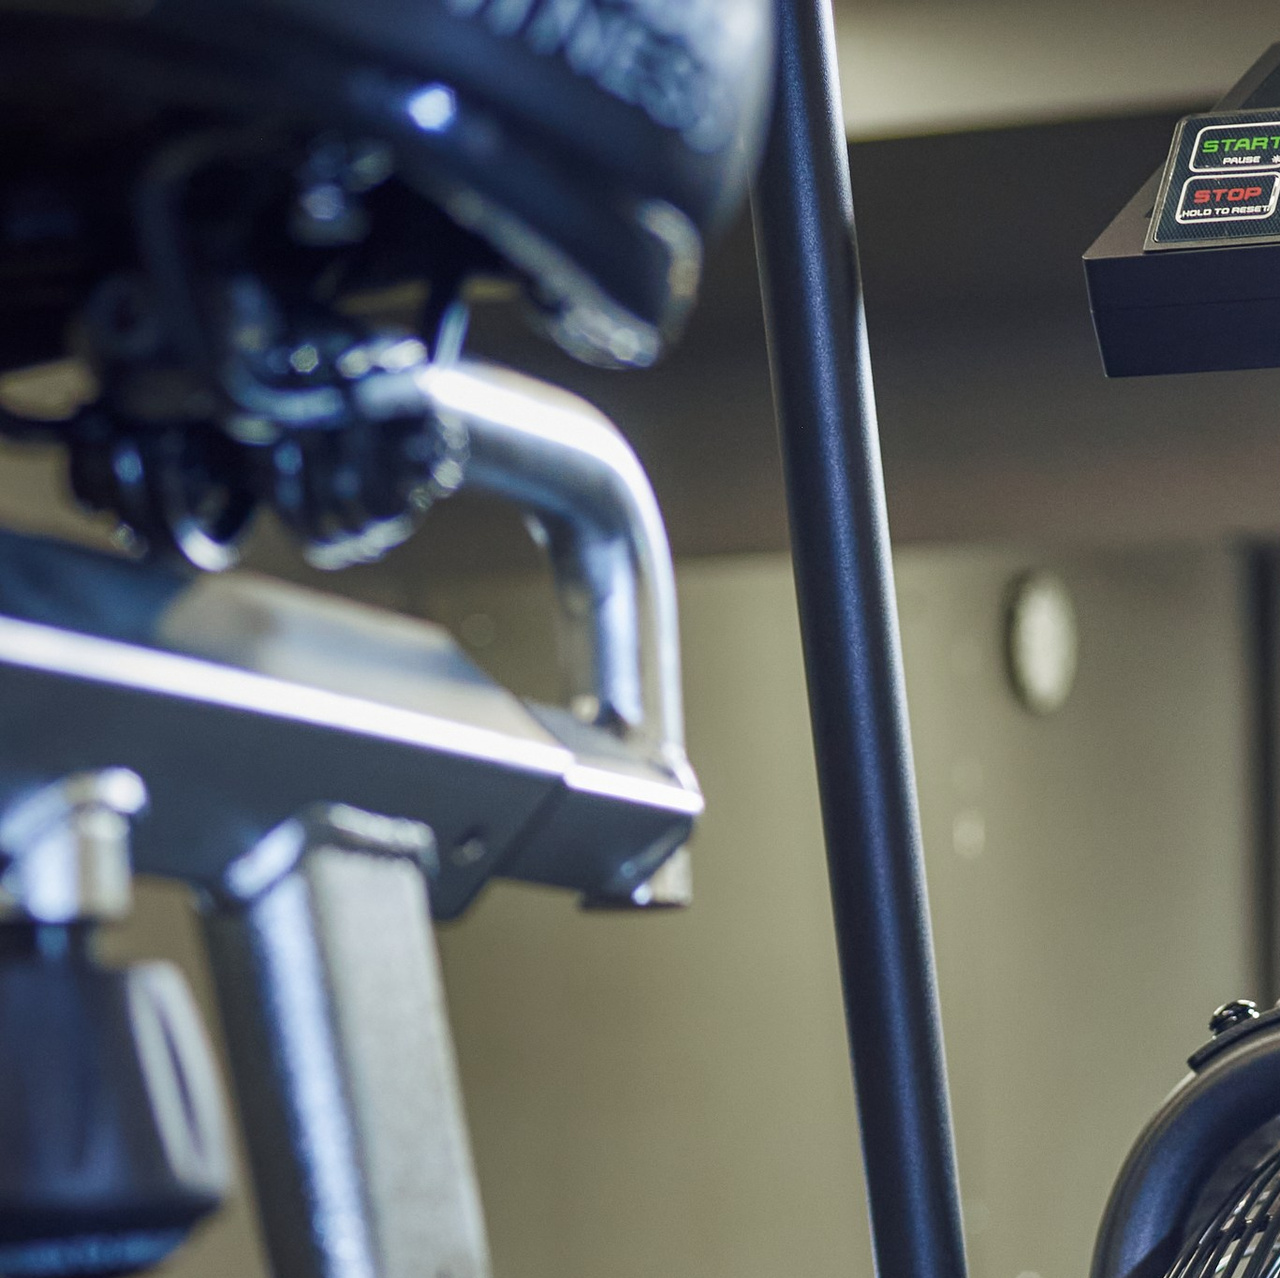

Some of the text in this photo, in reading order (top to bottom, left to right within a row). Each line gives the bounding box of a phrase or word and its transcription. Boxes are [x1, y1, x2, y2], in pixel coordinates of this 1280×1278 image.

[1223, 155, 1261, 165] PAUSE
[1194, 186, 1262, 203] STOP
[1182, 200, 1268, 217] HOLD TO RESET
